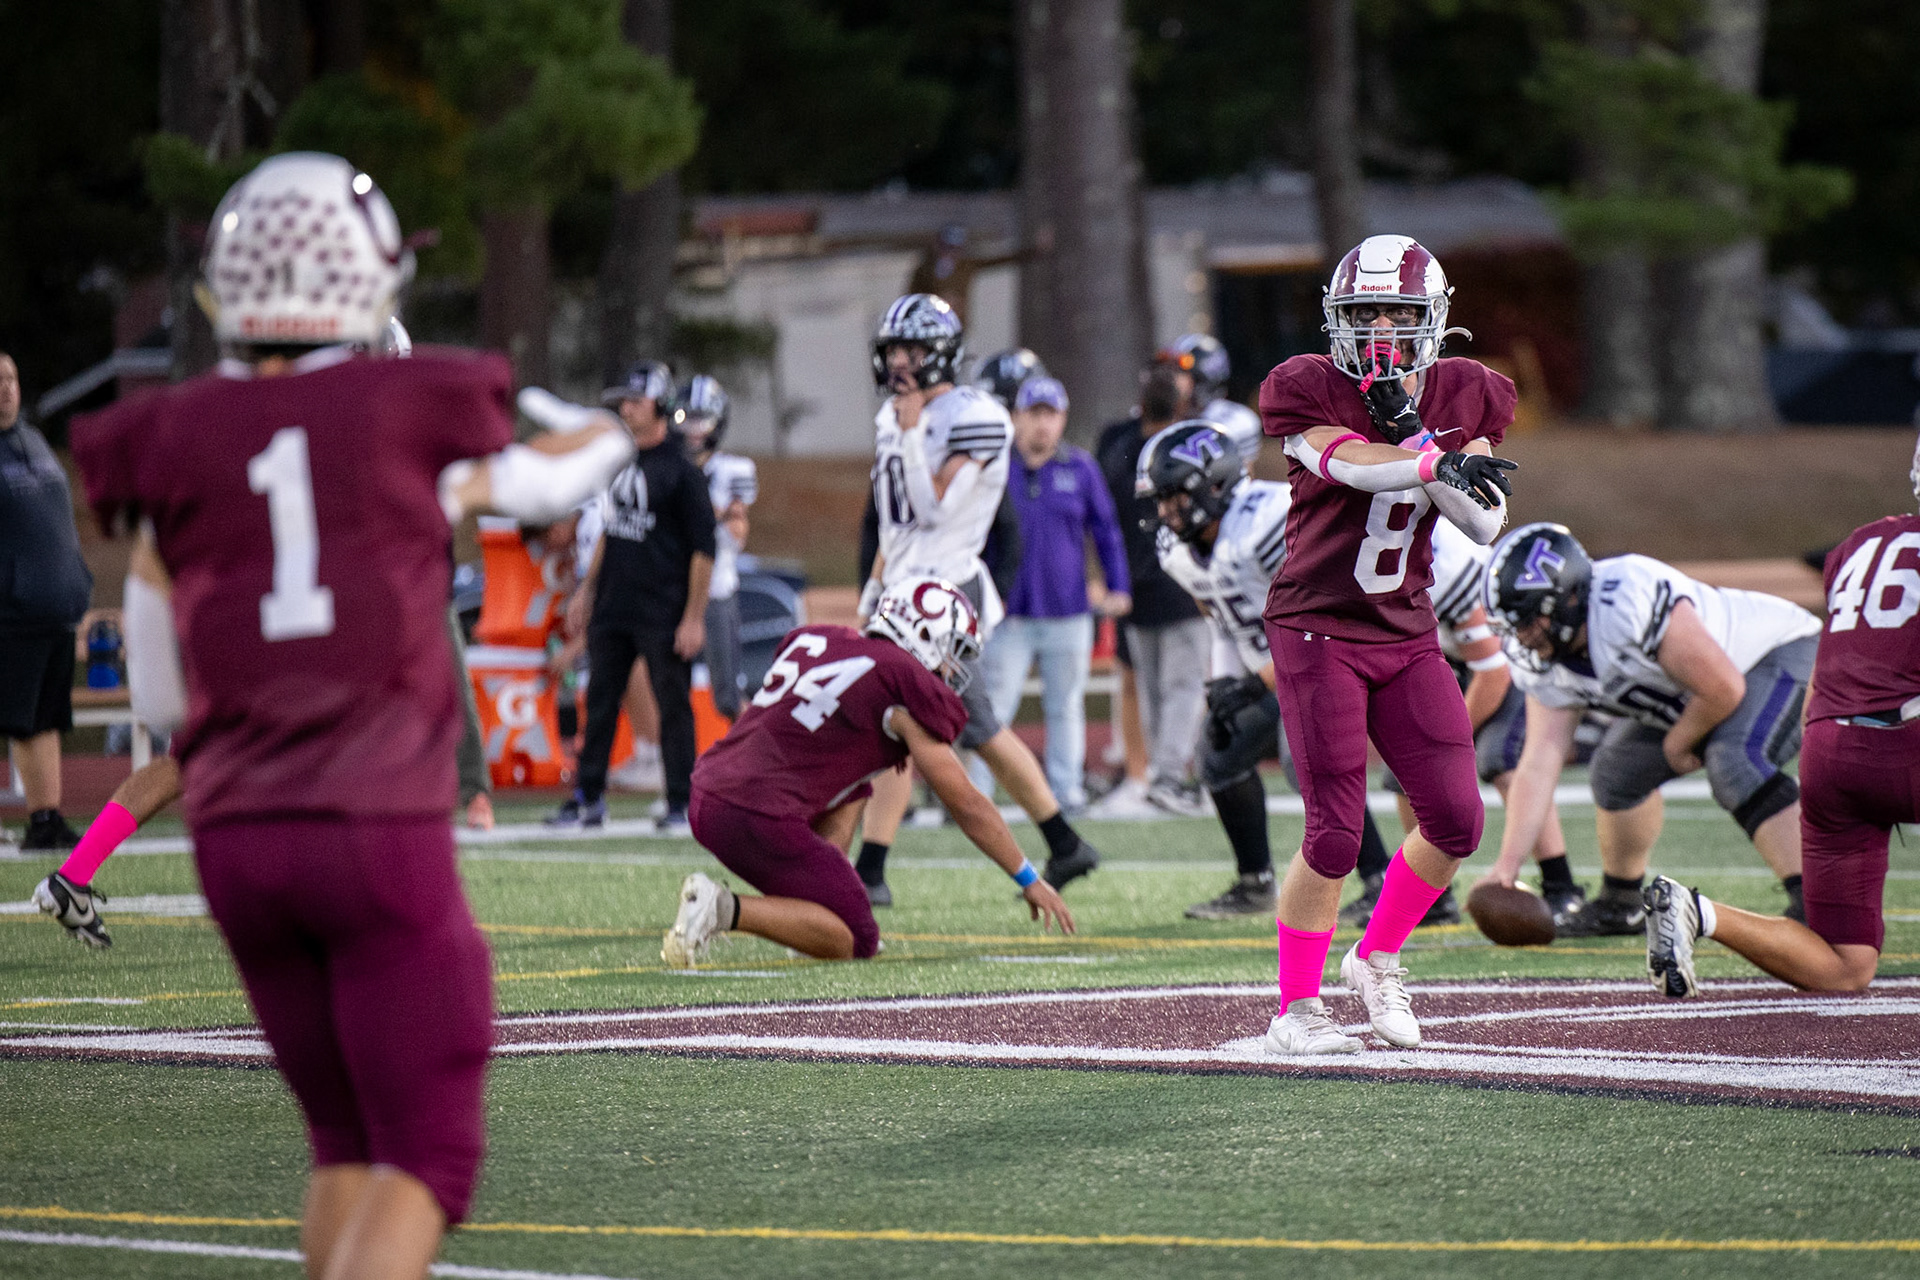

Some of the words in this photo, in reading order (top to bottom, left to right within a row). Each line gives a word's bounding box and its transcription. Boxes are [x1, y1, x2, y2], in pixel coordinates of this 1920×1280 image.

[247, 425, 336, 642] 1
[1353, 486, 1432, 594] 8
[1827, 531, 1920, 633] 46
[496, 682, 537, 728] G
[751, 632, 876, 733] 64
